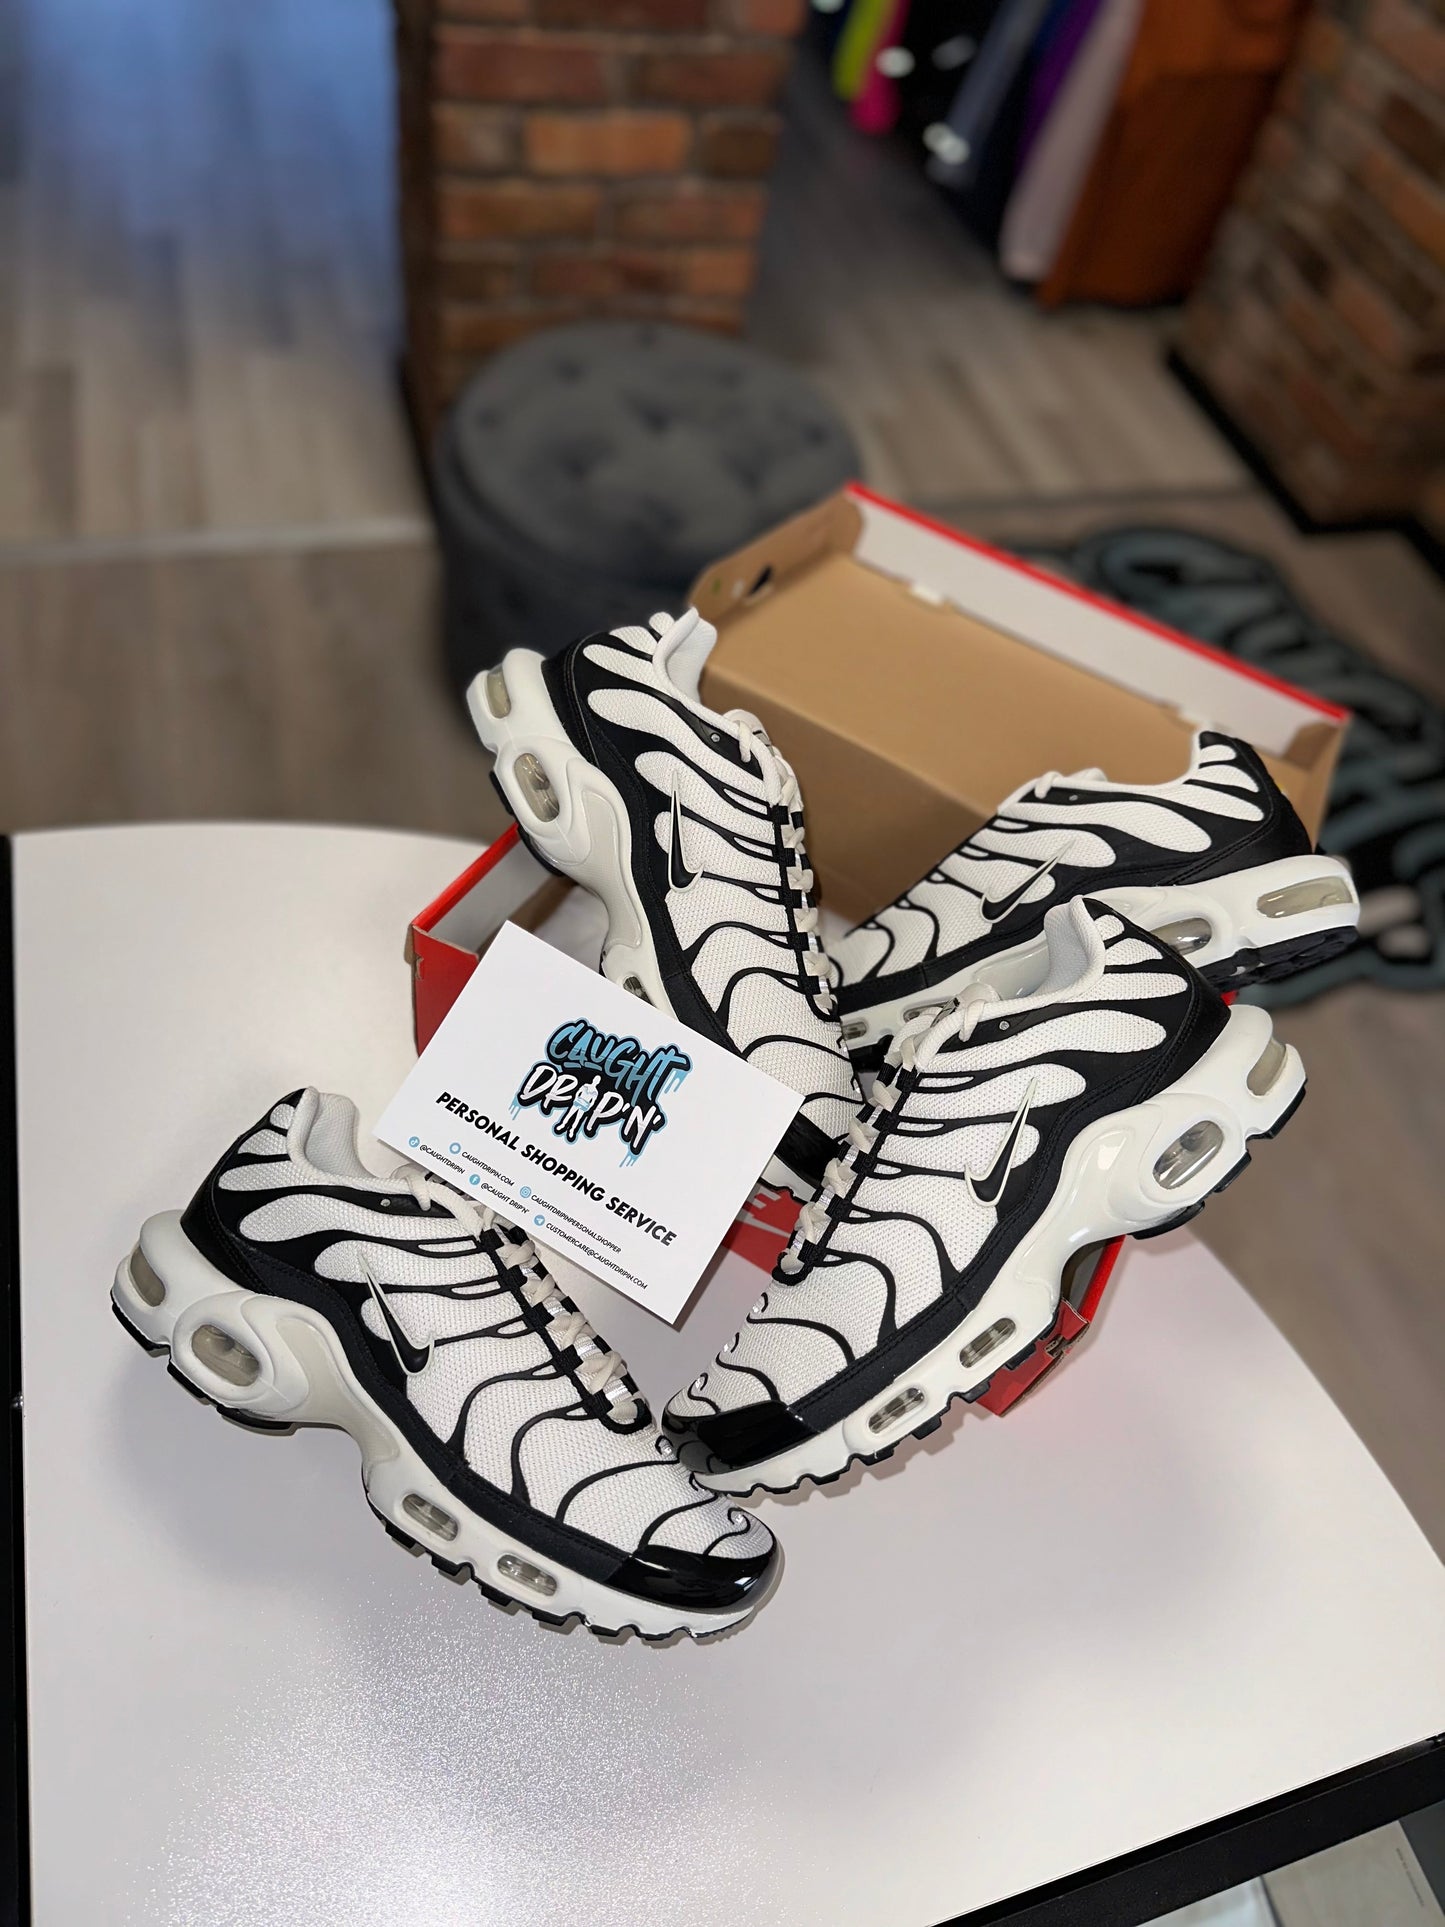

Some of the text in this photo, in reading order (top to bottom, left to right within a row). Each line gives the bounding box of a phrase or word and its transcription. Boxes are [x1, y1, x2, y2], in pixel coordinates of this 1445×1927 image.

[549, 1022, 688, 1107] CAUGHT
[419, 1144, 466, 1175] @CAUGHTDRIPIN
[436, 1092, 520, 1151] PERSONAL
[521, 1144, 606, 1202] SHOPPING
[605, 1197, 677, 1247] SERVICE
[461, 1151, 515, 1187] CAUGHTDRIPIN.COM
[480, 1182, 510, 1203] @CAUGHT
[530, 1194, 622, 1254] CAUGHTDRIPINPERSONALSHOPPER
[545, 1222, 648, 1290] CUSTOMERCARE@CAUGHTDRIPIN.COM
